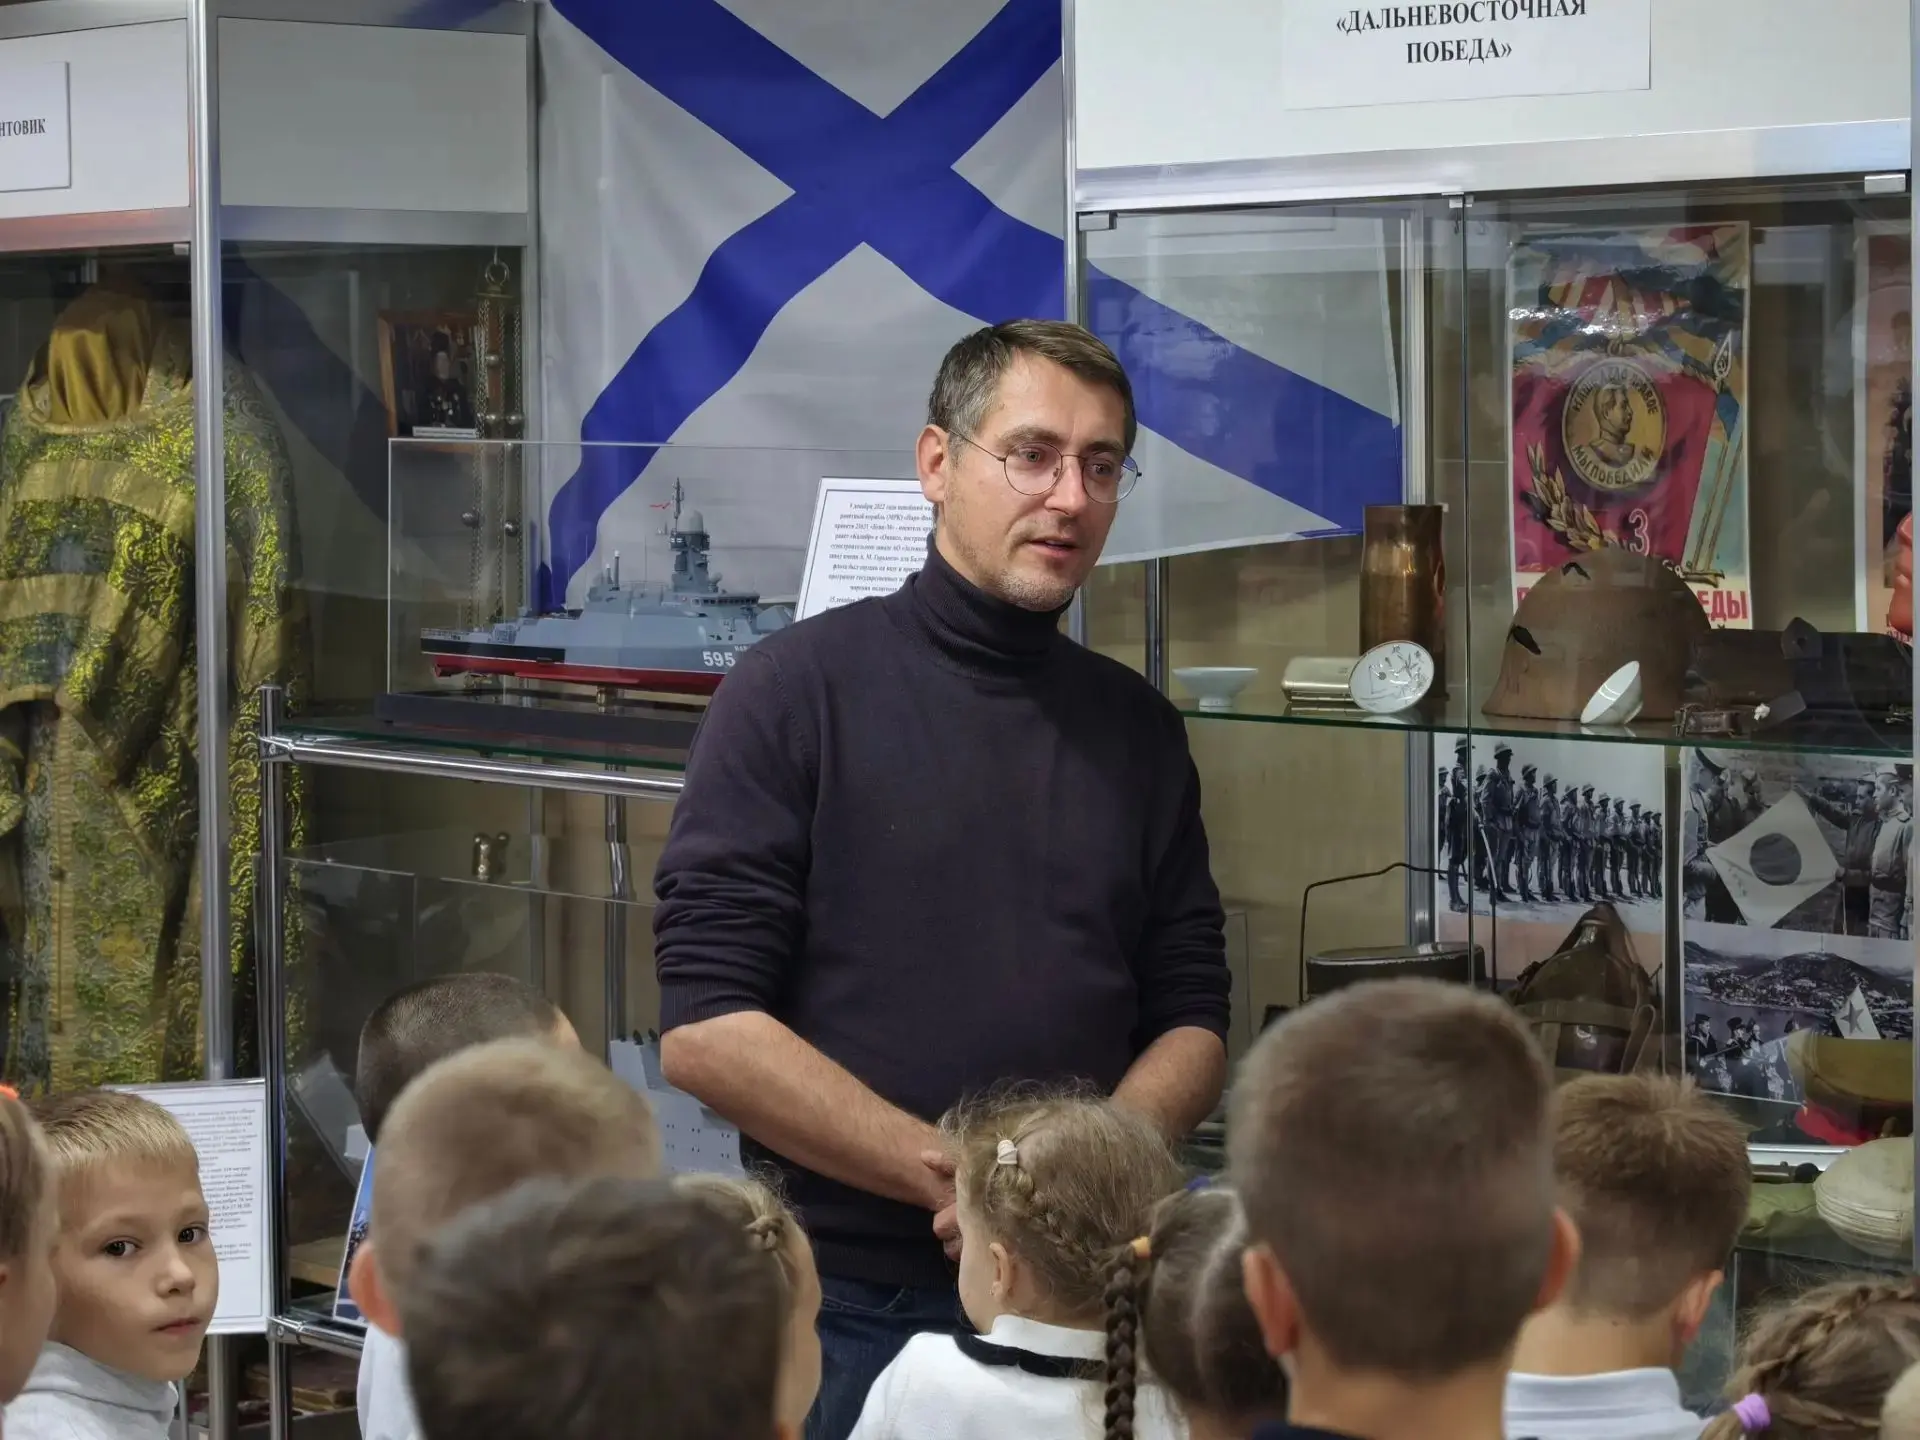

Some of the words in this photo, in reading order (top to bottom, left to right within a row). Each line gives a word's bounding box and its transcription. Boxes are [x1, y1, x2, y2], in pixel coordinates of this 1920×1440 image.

[1336, 0, 1587, 35] «ДАЛЬНЕВОСТОЧНАЯ
[1406, 37, 1512, 64] ПОБЕДА»
[1697, 590, 1748, 622] ЕДЫ
[703, 651, 736, 667] 595
